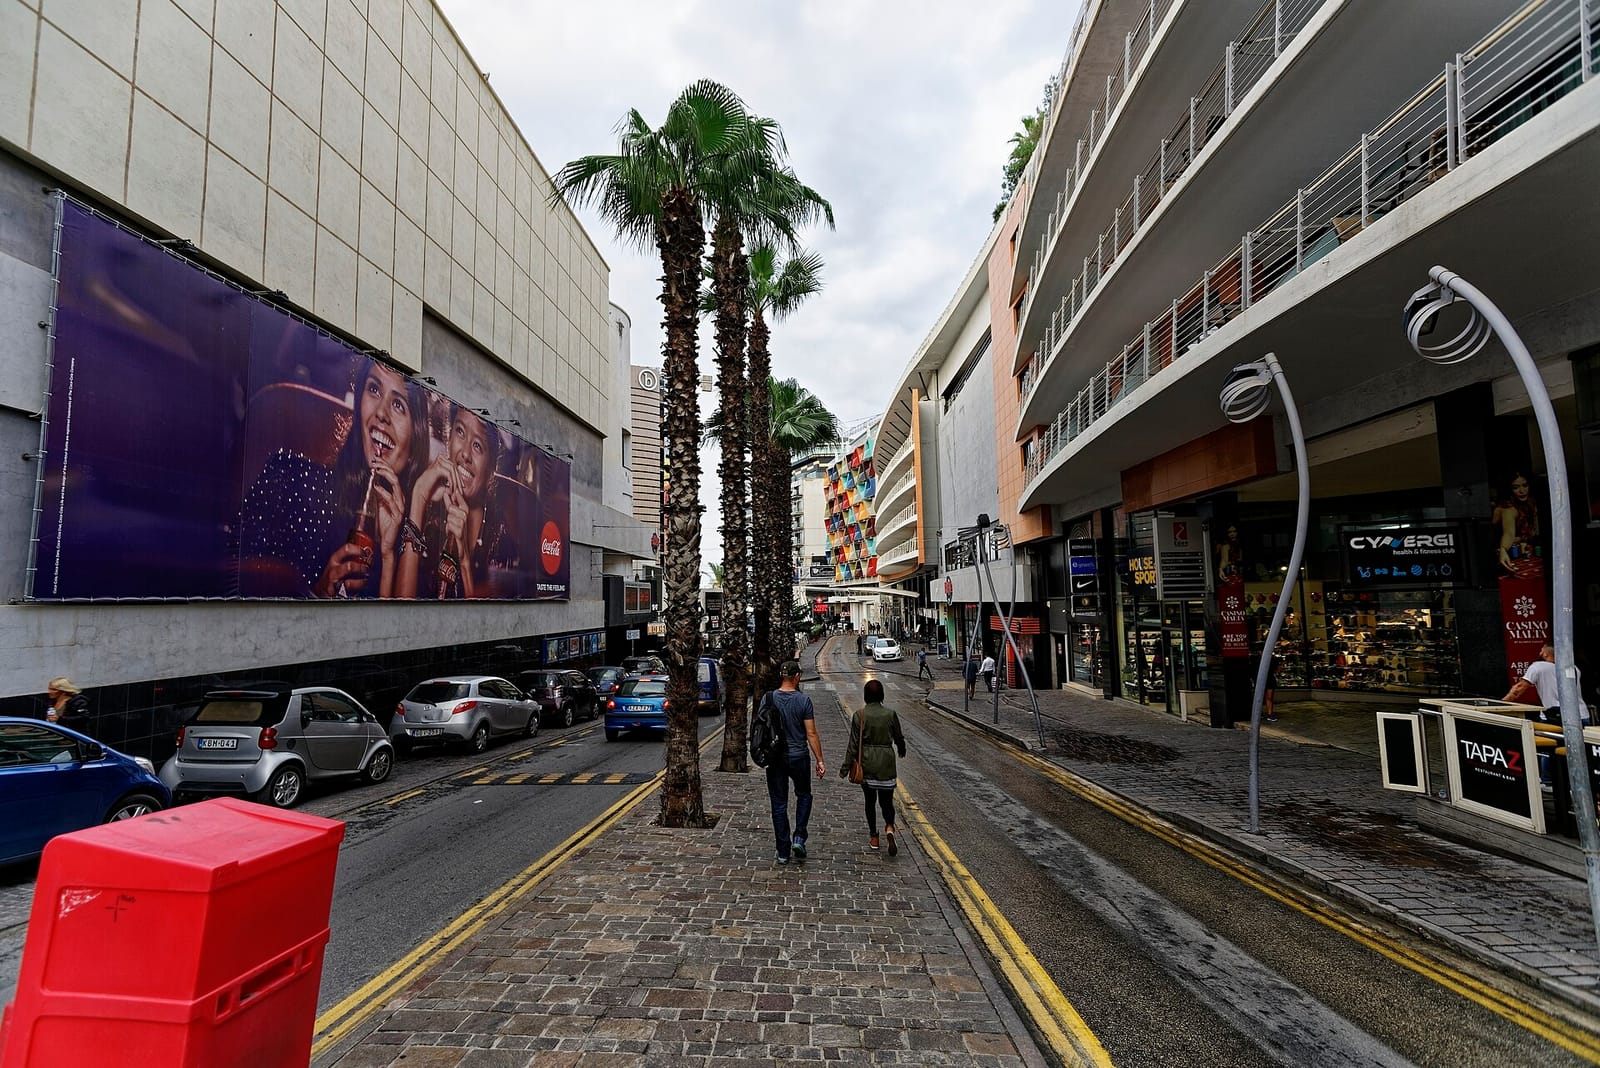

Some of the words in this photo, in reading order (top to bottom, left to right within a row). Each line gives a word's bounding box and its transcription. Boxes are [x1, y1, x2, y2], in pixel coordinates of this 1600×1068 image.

[1134, 570, 1156, 584] SPOR
[1506, 620, 1549, 631] CASINO
[1509, 630, 1548, 639] MALTA
[1460, 740, 1522, 772] TAPAZ
[1474, 767, 1502, 778] RESTAURANT
